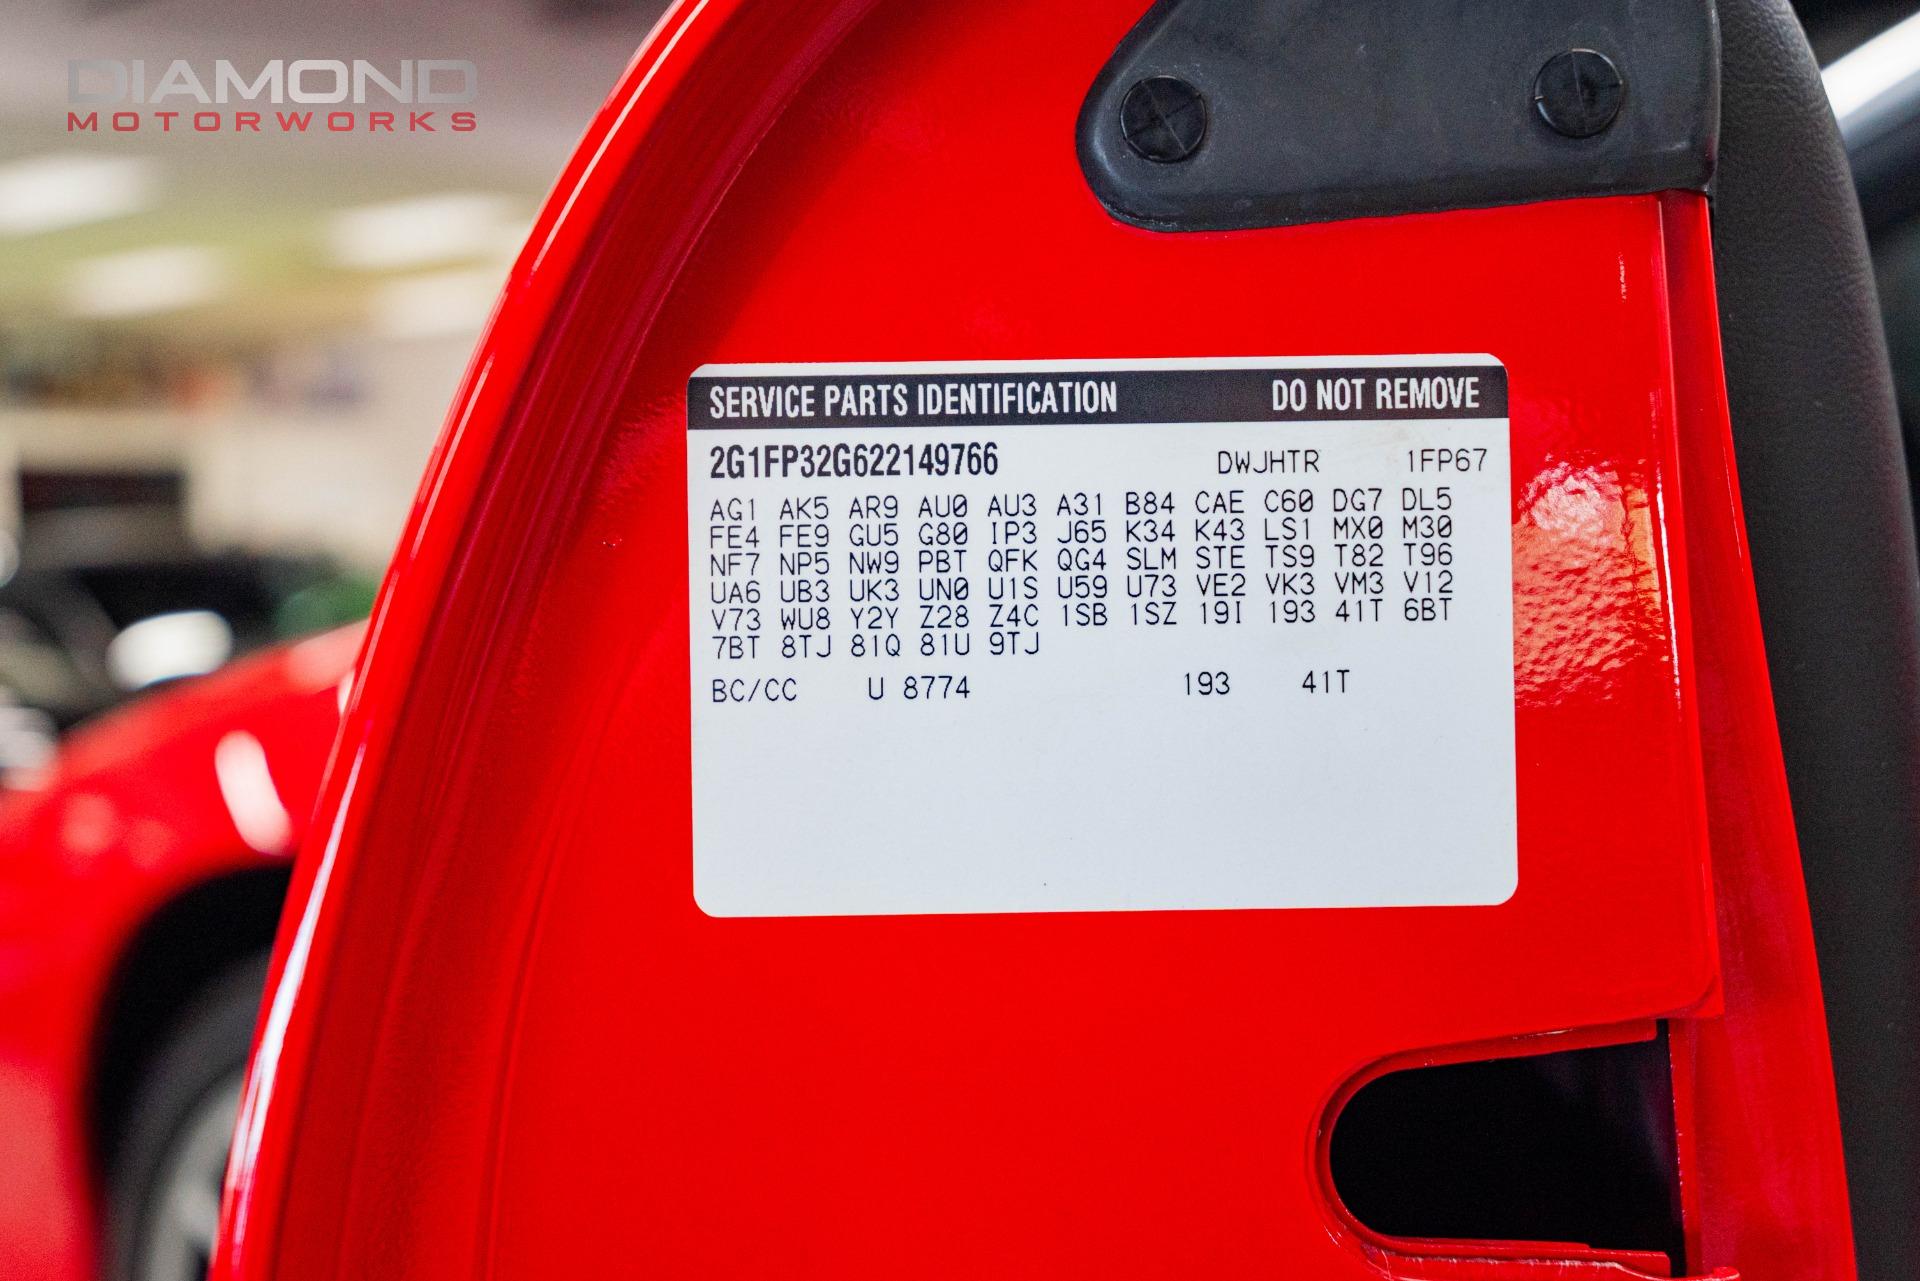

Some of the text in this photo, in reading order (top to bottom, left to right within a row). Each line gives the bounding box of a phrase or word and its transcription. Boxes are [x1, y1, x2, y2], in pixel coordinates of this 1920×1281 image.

[709, 380, 1118, 418] SERVICE PARTS IDENTIFICATION
[1271, 376, 1480, 412] DO NOT REMOVE
[709, 441, 999, 480] 2G1FP32G622149766
[1217, 448, 1320, 475] DWJHTR
[1408, 447, 1488, 473] 1FP67
[709, 486, 1452, 522] AG1 AK5 AR9 AU0 AU3 A31 B84 CAE C60 DG7 DL5
[709, 514, 1453, 549] FE4 FE9 GU5 G80 IP3 J65 K34 K43 LS1 MX0 M30
[710, 541, 1453, 577] NF7 NP5 NW9 PBT QFK QG4 SLM STE TS9 T82 T96
[710, 569, 1454, 605] UA6 UB3 UK3 UN0 U1S U59 U73 VE2 VK3 VM3 V12
[711, 596, 1453, 632] V73 WU8 Y2Y Z28 Z4C 1SB 1SZ 19I 193 41T 6BT
[711, 630, 1040, 660] 7BT 8TJ 81Q 81U 9TJ
[712, 668, 1351, 703] BC/CC U 8774 193 41T
